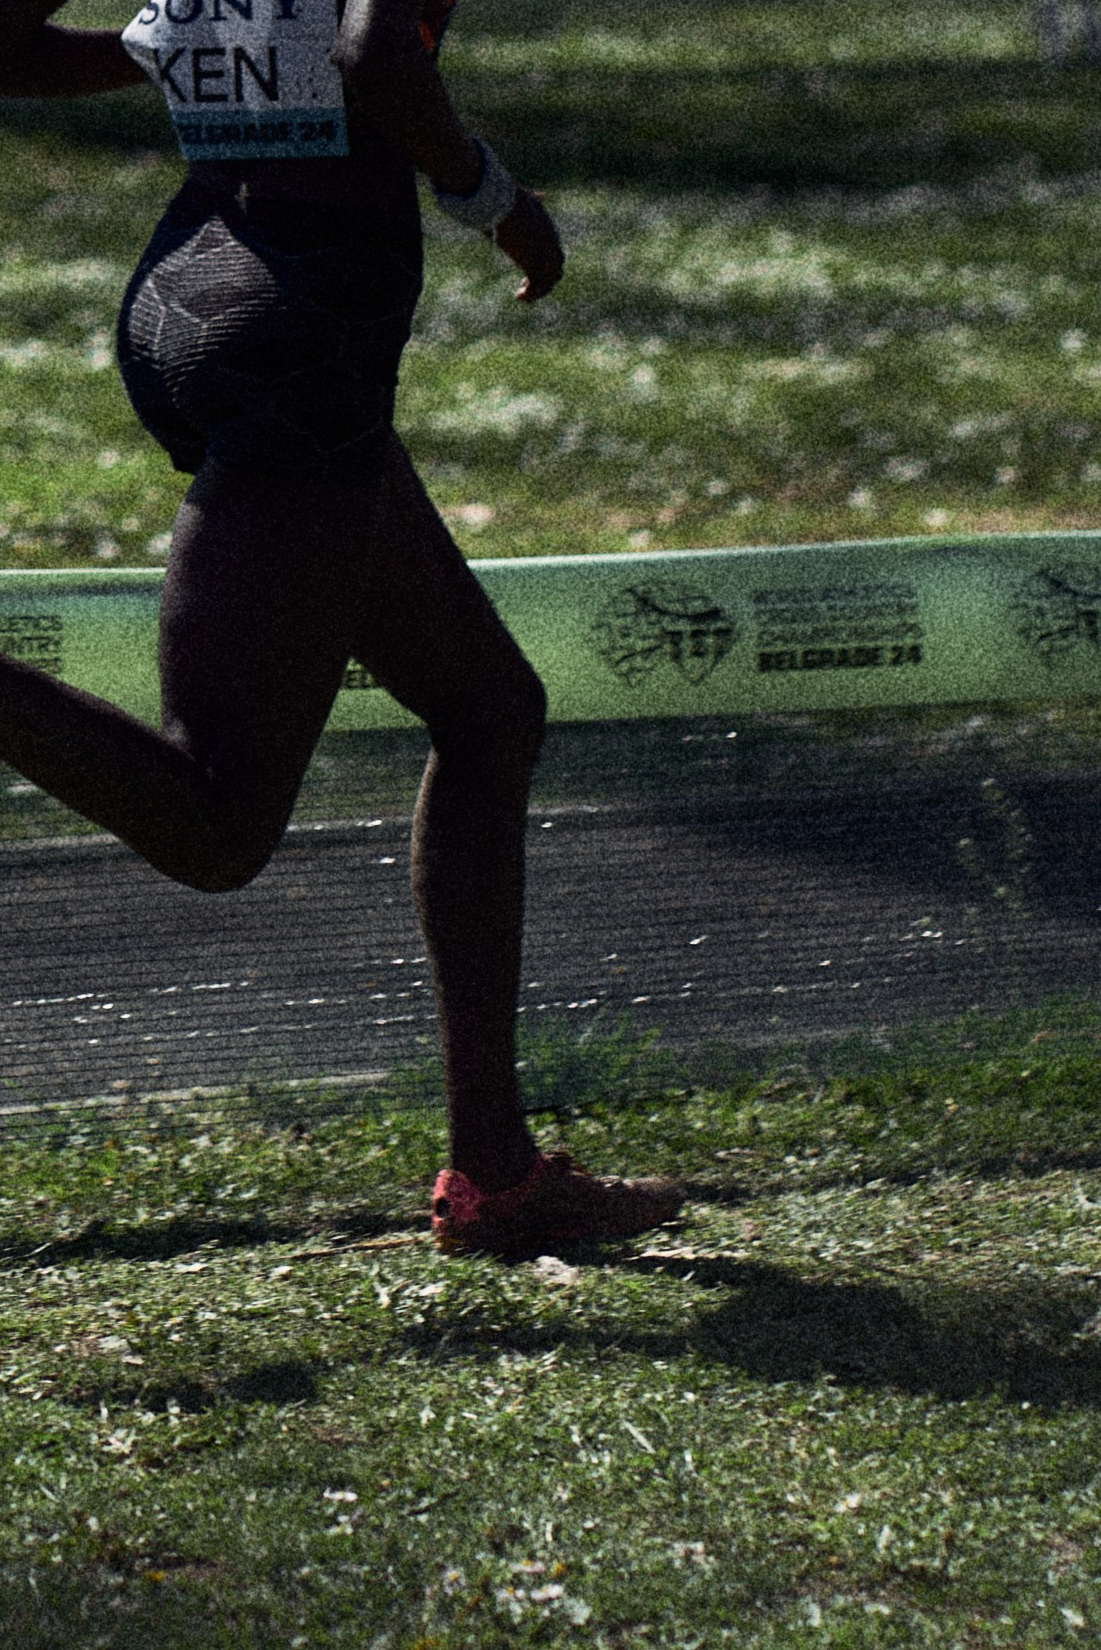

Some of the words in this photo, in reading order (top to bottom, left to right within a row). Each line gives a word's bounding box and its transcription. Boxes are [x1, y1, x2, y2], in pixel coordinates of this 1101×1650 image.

[152, 46, 281, 103] KEN
[296, 119, 338, 142] 24
[757, 646, 881, 672] BELGRADE
[889, 643, 923, 666] 24
